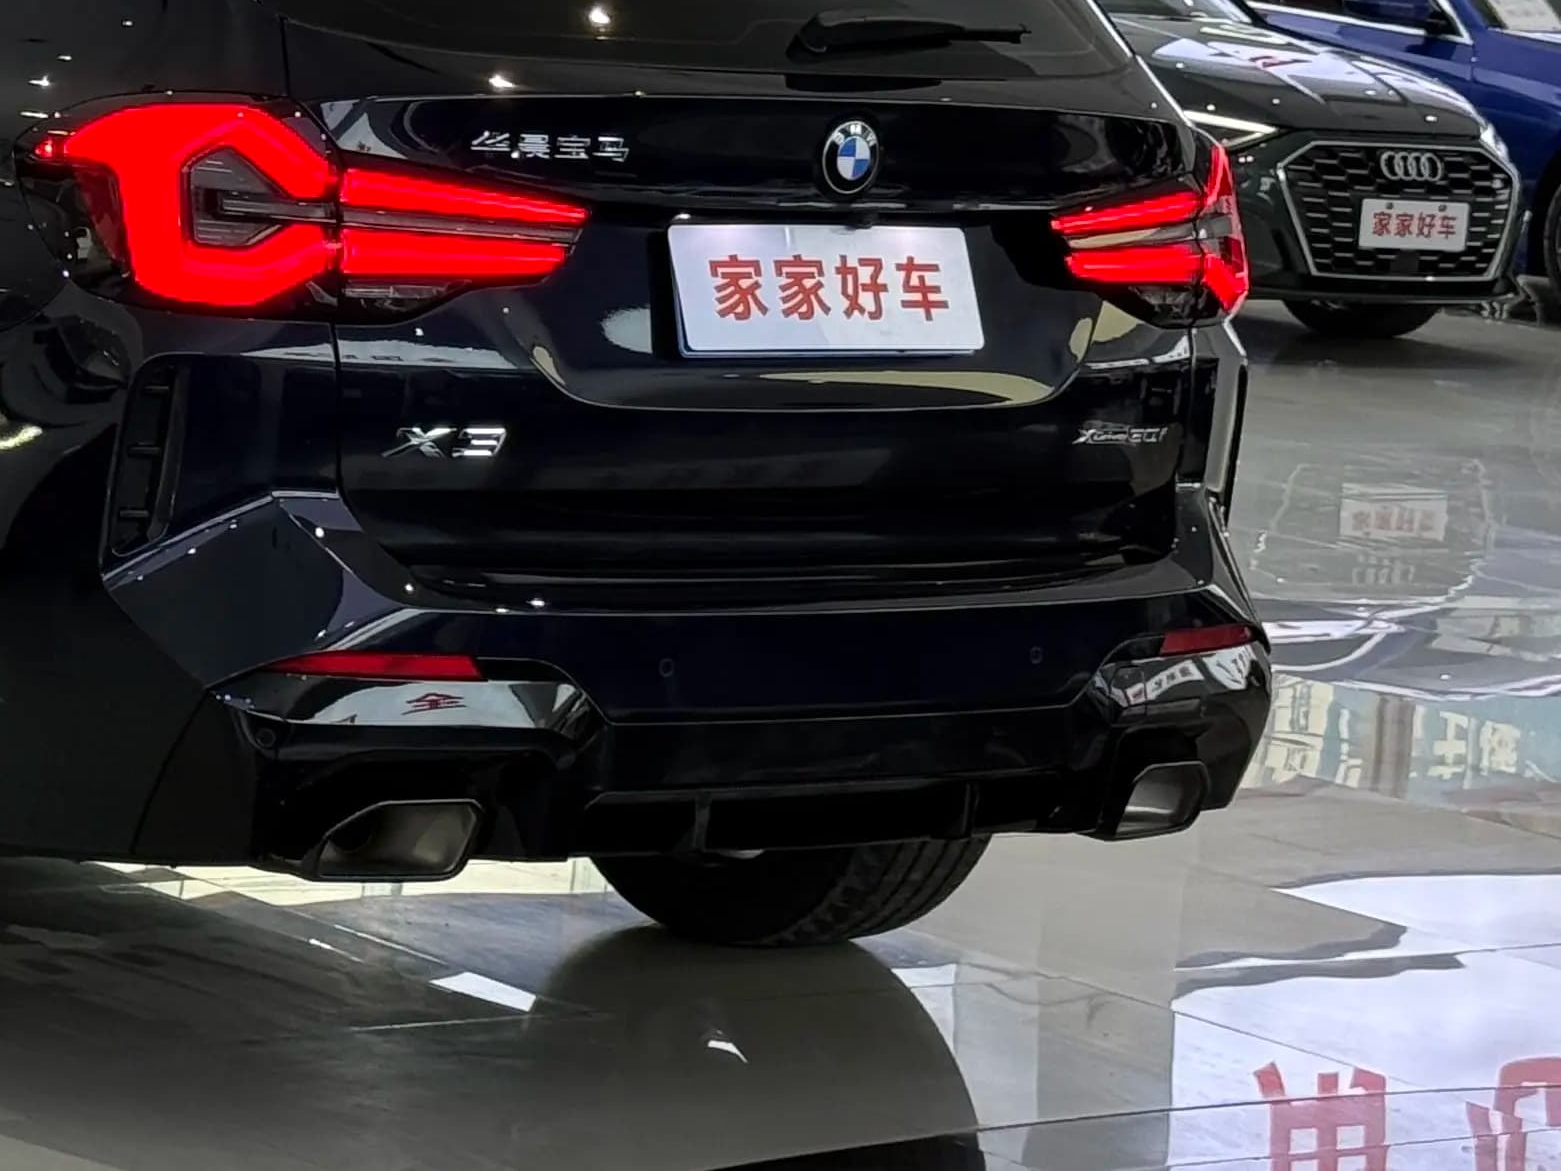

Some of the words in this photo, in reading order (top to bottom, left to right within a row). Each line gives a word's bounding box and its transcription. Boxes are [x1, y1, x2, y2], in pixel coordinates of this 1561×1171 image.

[1371, 211, 1457, 240] 家家好车
[708, 254, 951, 322] 家家好车
[382, 425, 508, 459] X3
